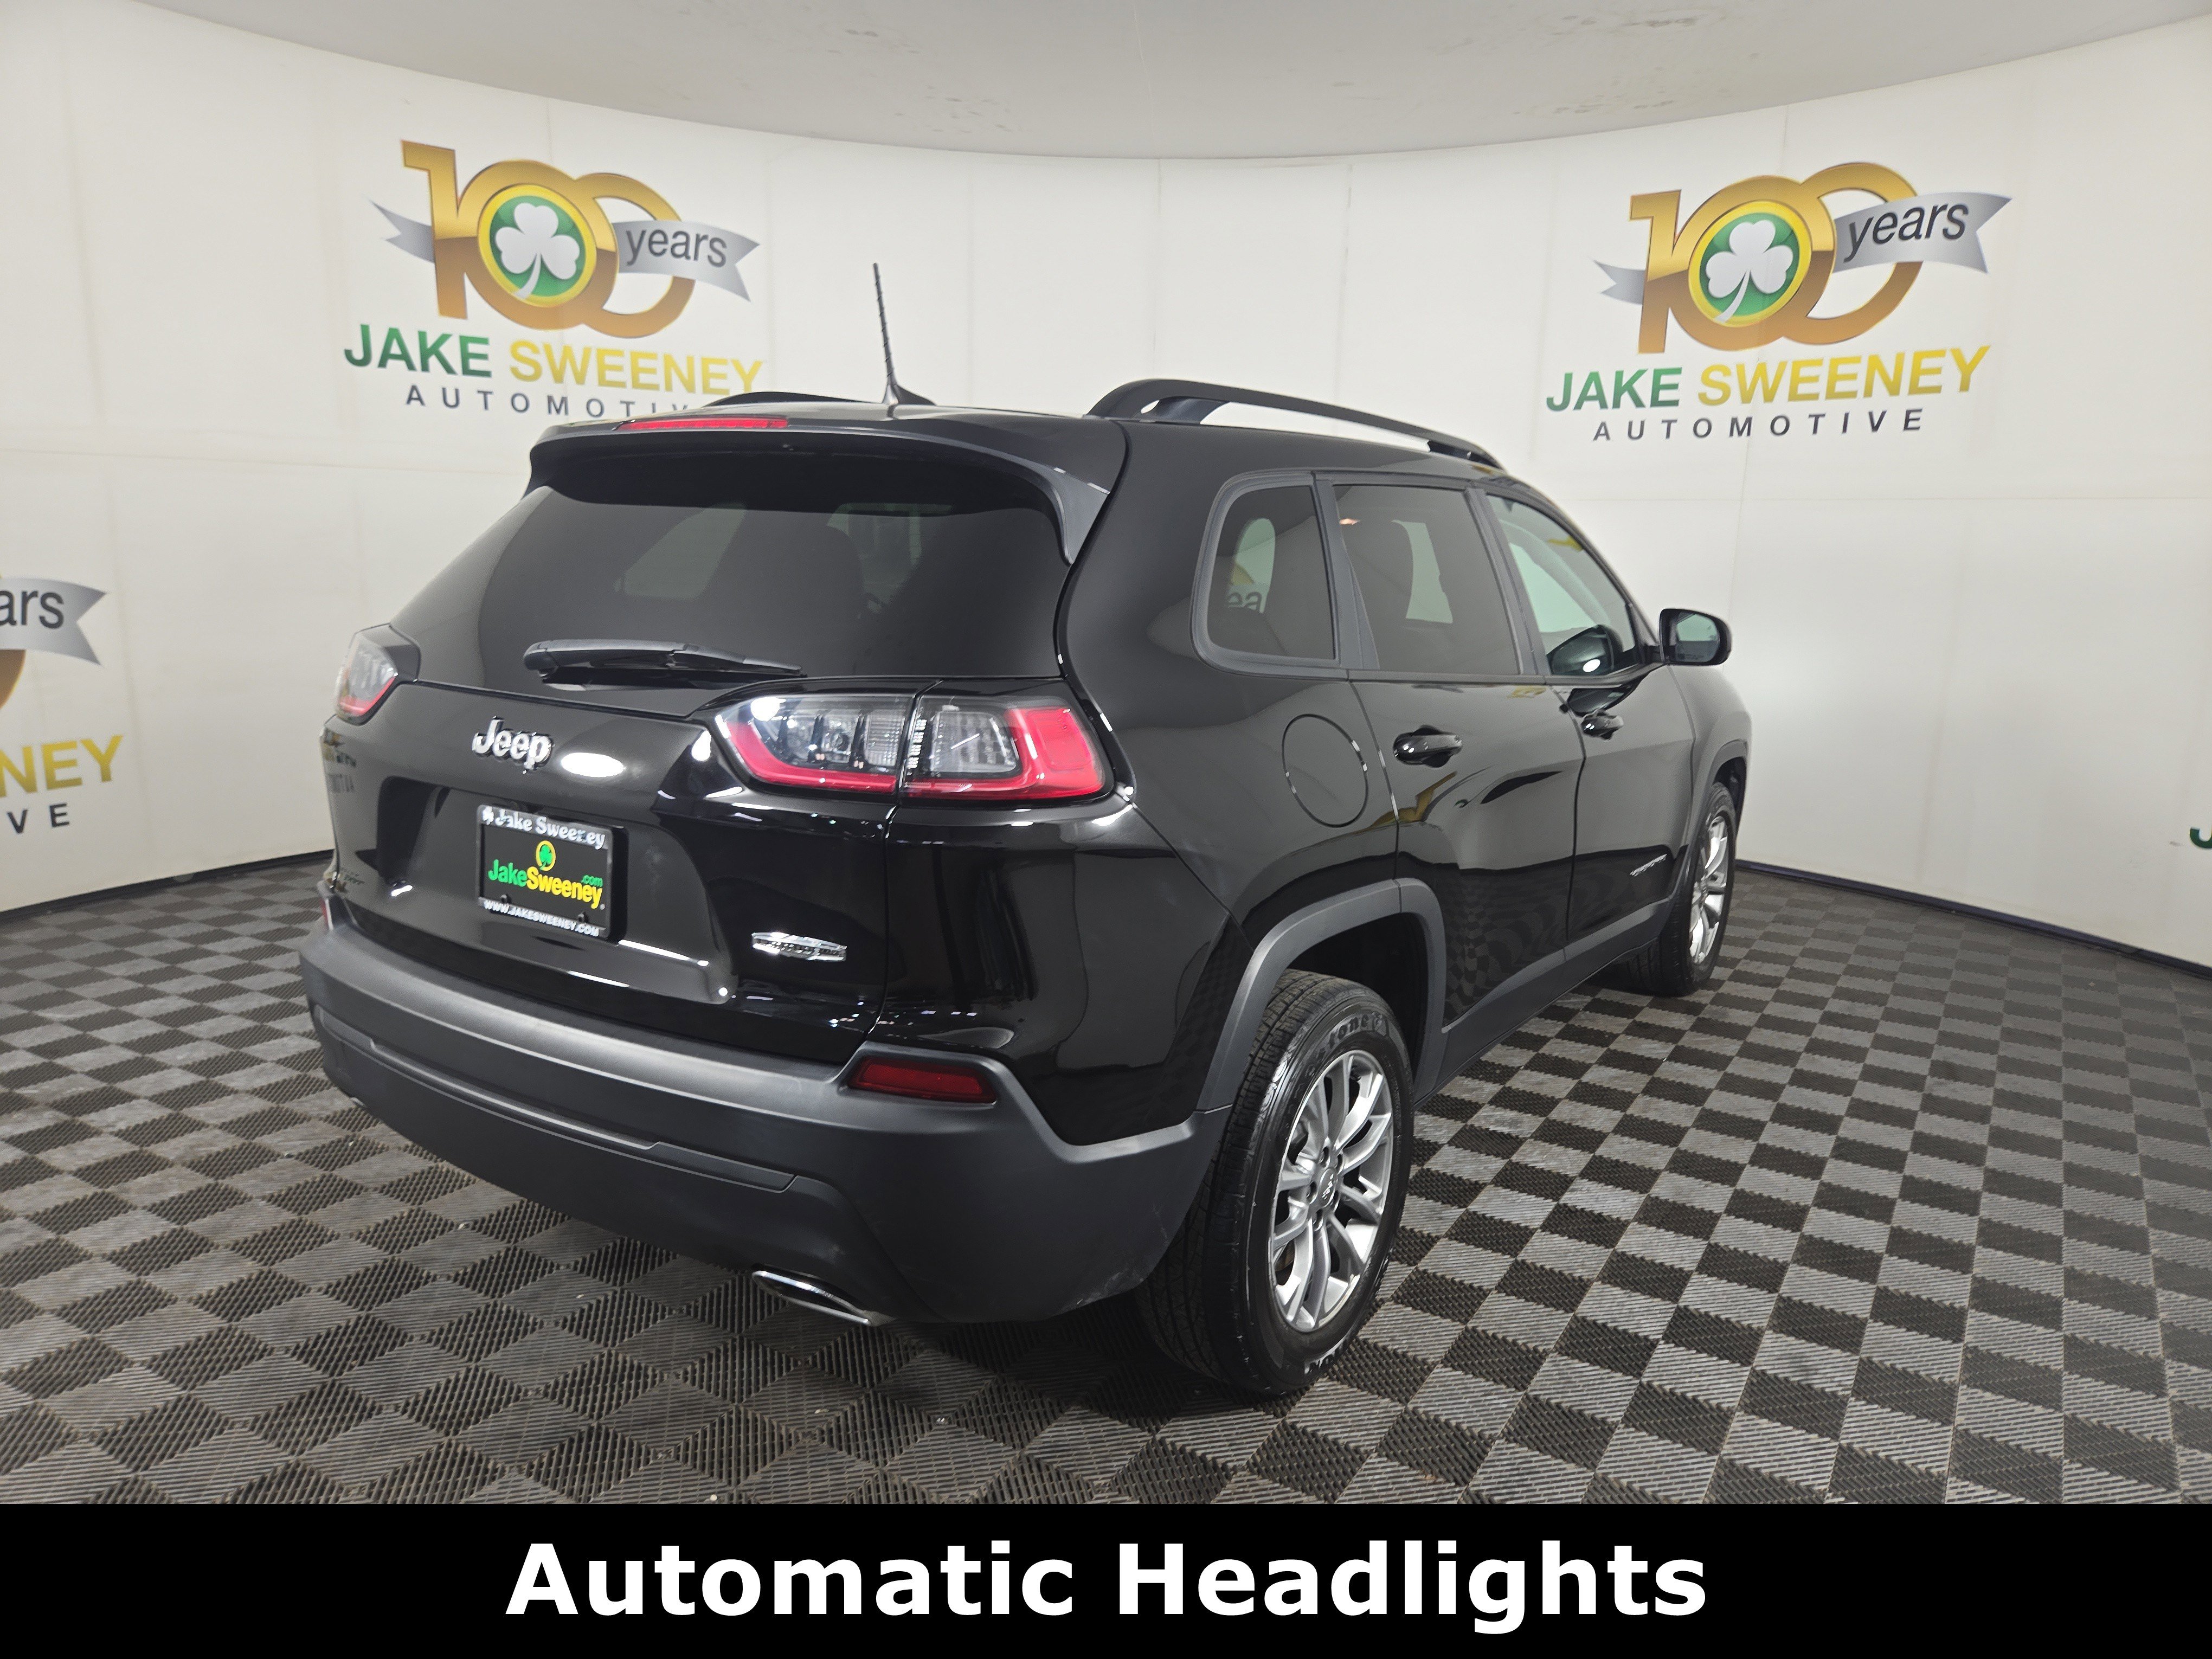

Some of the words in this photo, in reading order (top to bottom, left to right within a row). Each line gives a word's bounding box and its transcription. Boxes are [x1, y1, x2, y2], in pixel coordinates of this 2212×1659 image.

[401, 140, 697, 339] 100
[625, 228, 728, 268] years
[1629, 161, 1924, 354] 100
[1845, 203, 1969, 262] years
[344, 324, 492, 378] JAKE
[510, 339, 763, 396] SWEENEY
[1546, 366, 1683, 412] JAKE
[1698, 345, 1991, 406] SWEENEY
[1593, 408, 1924, 442] AUTOMOTIVE
[472, 715, 553, 774] Jeep
[494, 809, 533, 832] Jake
